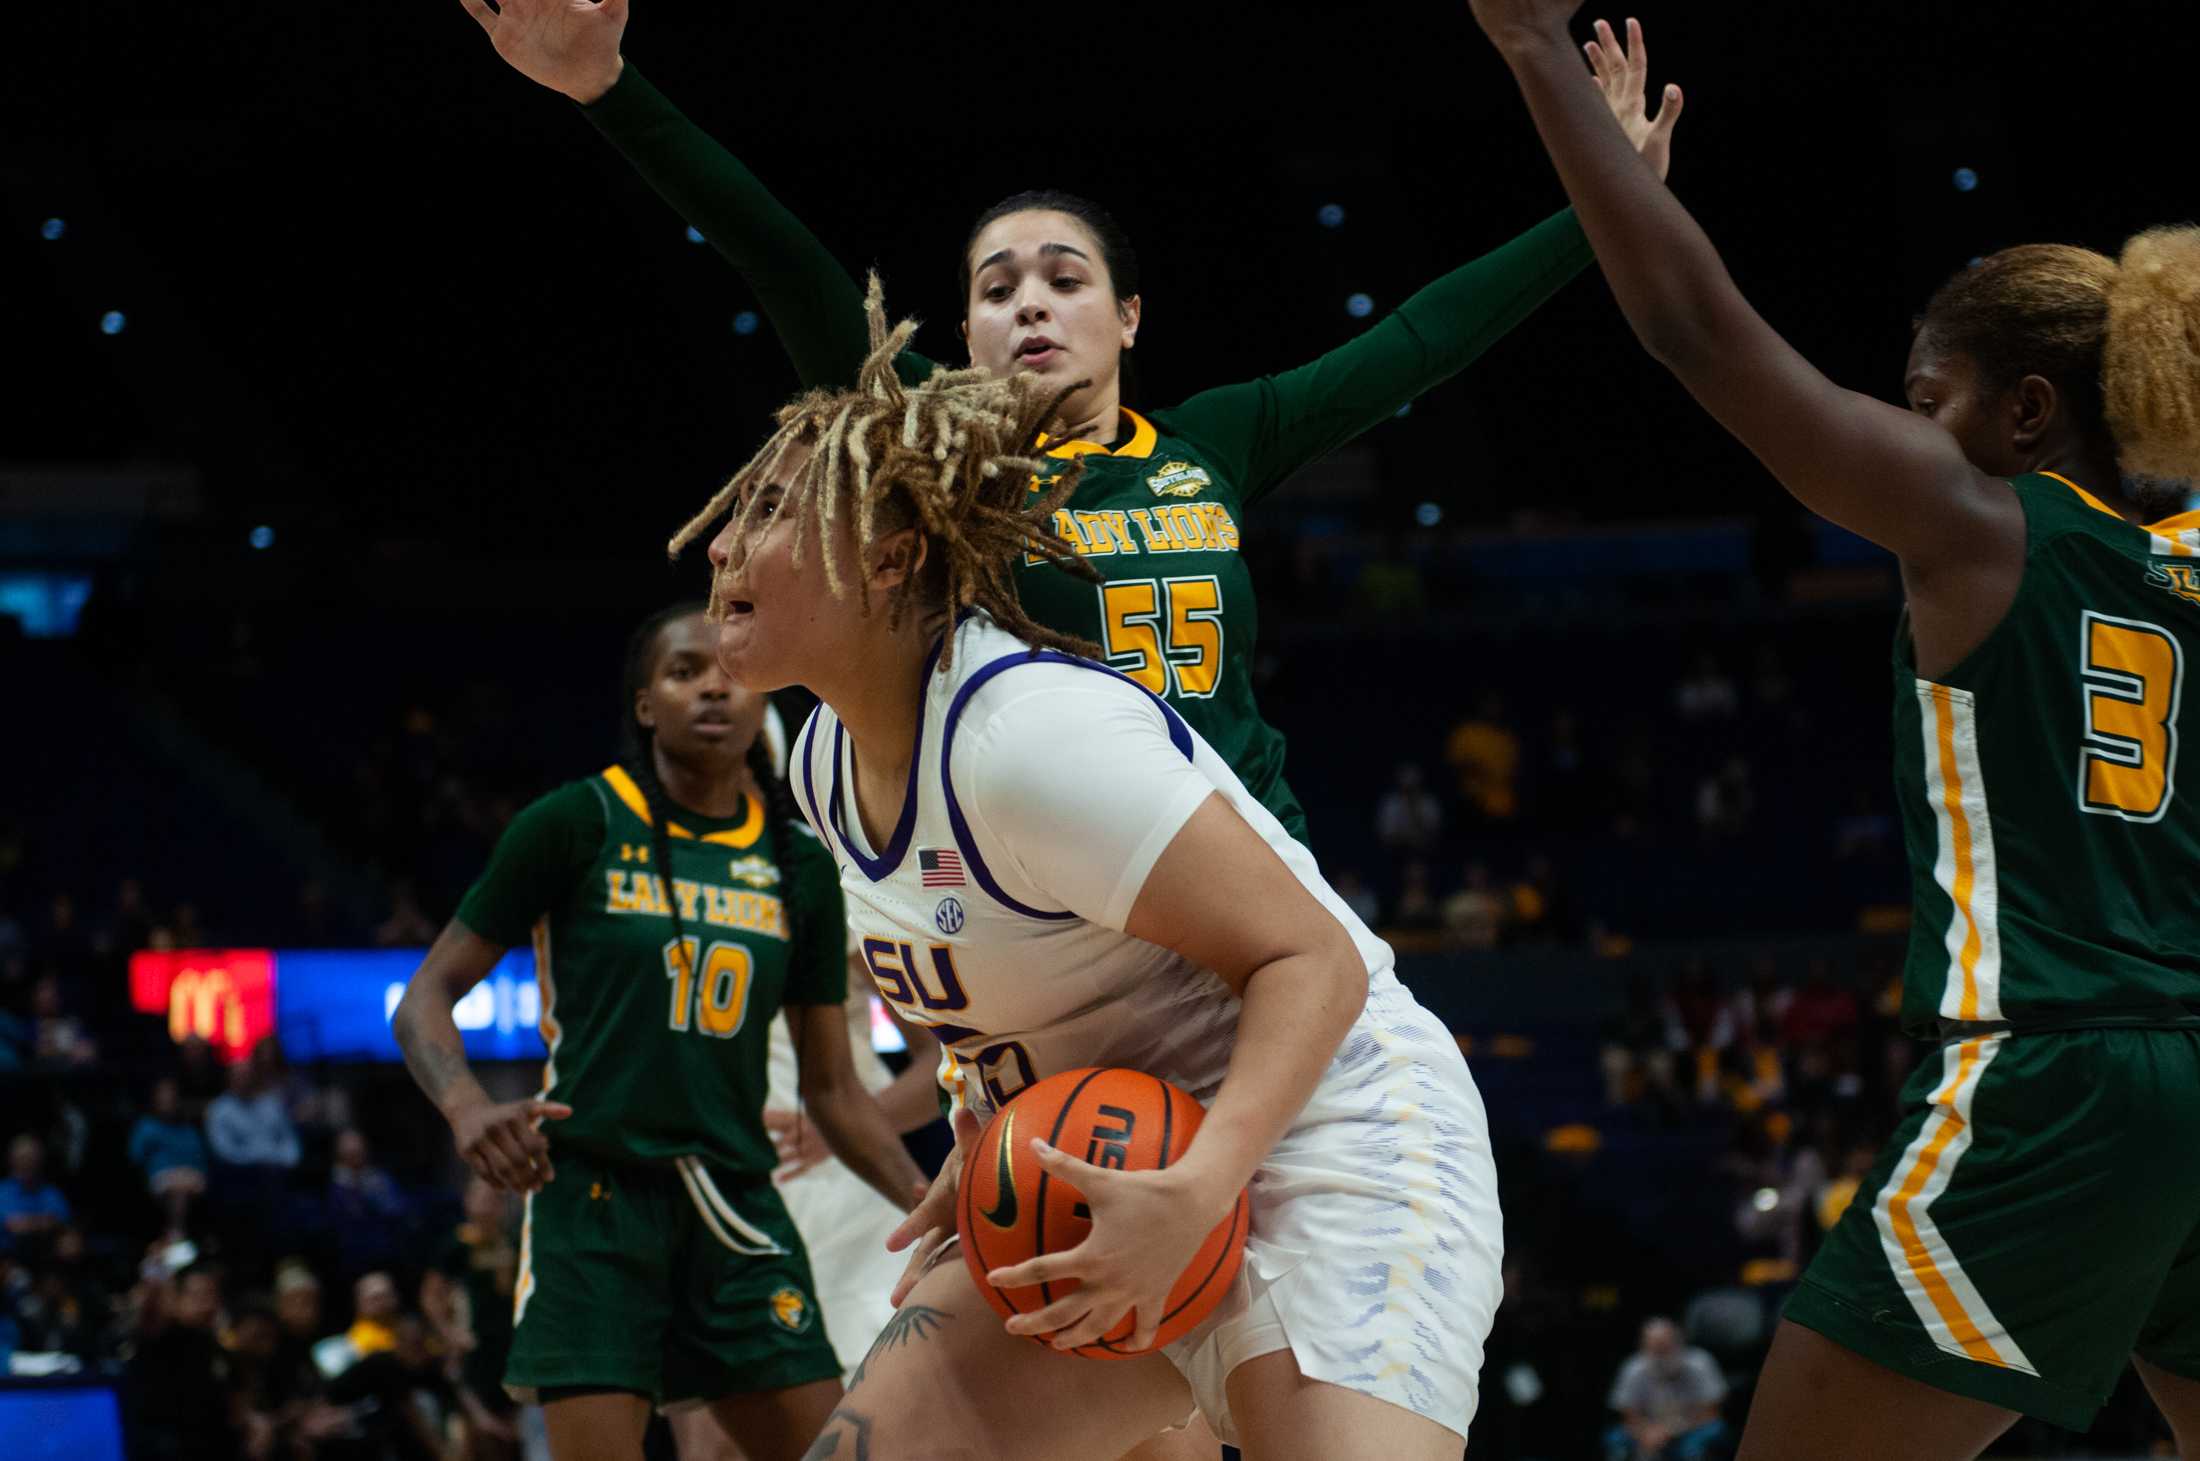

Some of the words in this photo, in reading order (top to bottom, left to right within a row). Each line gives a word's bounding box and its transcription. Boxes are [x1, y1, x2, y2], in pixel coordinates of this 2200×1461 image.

[1134, 502, 1240, 554] LIONS
[1097, 575, 1223, 699] 55
[2078, 610, 2185, 823] 3
[936, 898, 964, 932] SEC
[663, 934, 754, 1039] 10
[863, 933, 971, 1012] SU
